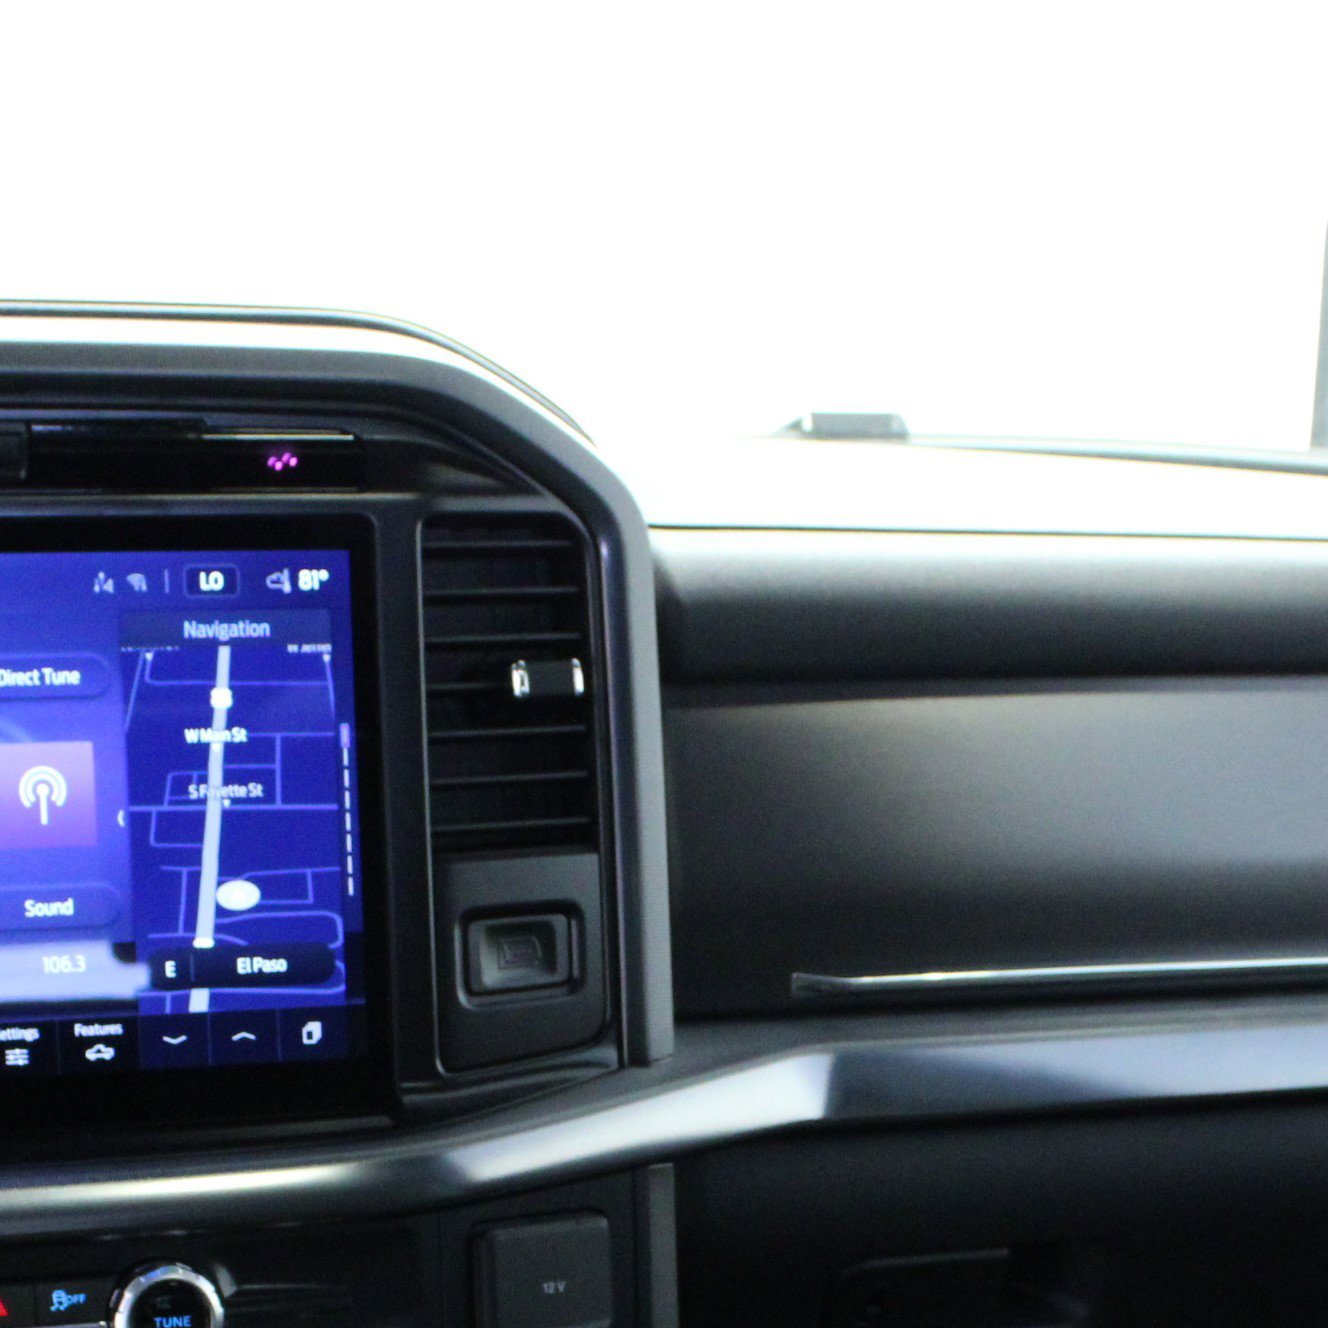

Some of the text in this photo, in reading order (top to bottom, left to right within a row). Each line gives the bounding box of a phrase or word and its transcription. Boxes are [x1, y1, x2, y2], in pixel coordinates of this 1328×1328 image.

[198, 570, 224, 591] LO
[182, 618, 271, 641] Navigation
[42, 666, 80, 686] Tune
[183, 727, 200, 744] W
[231, 726, 247, 743] St
[188, 782, 199, 800] S
[247, 781, 263, 798] St
[23, 897, 74, 918] Sound
[41, 953, 86, 975] 106.3
[164, 956, 287, 978] E El Paso
[73, 1021, 123, 1039] Features
[152, 1314, 192, 1328] TUNE
